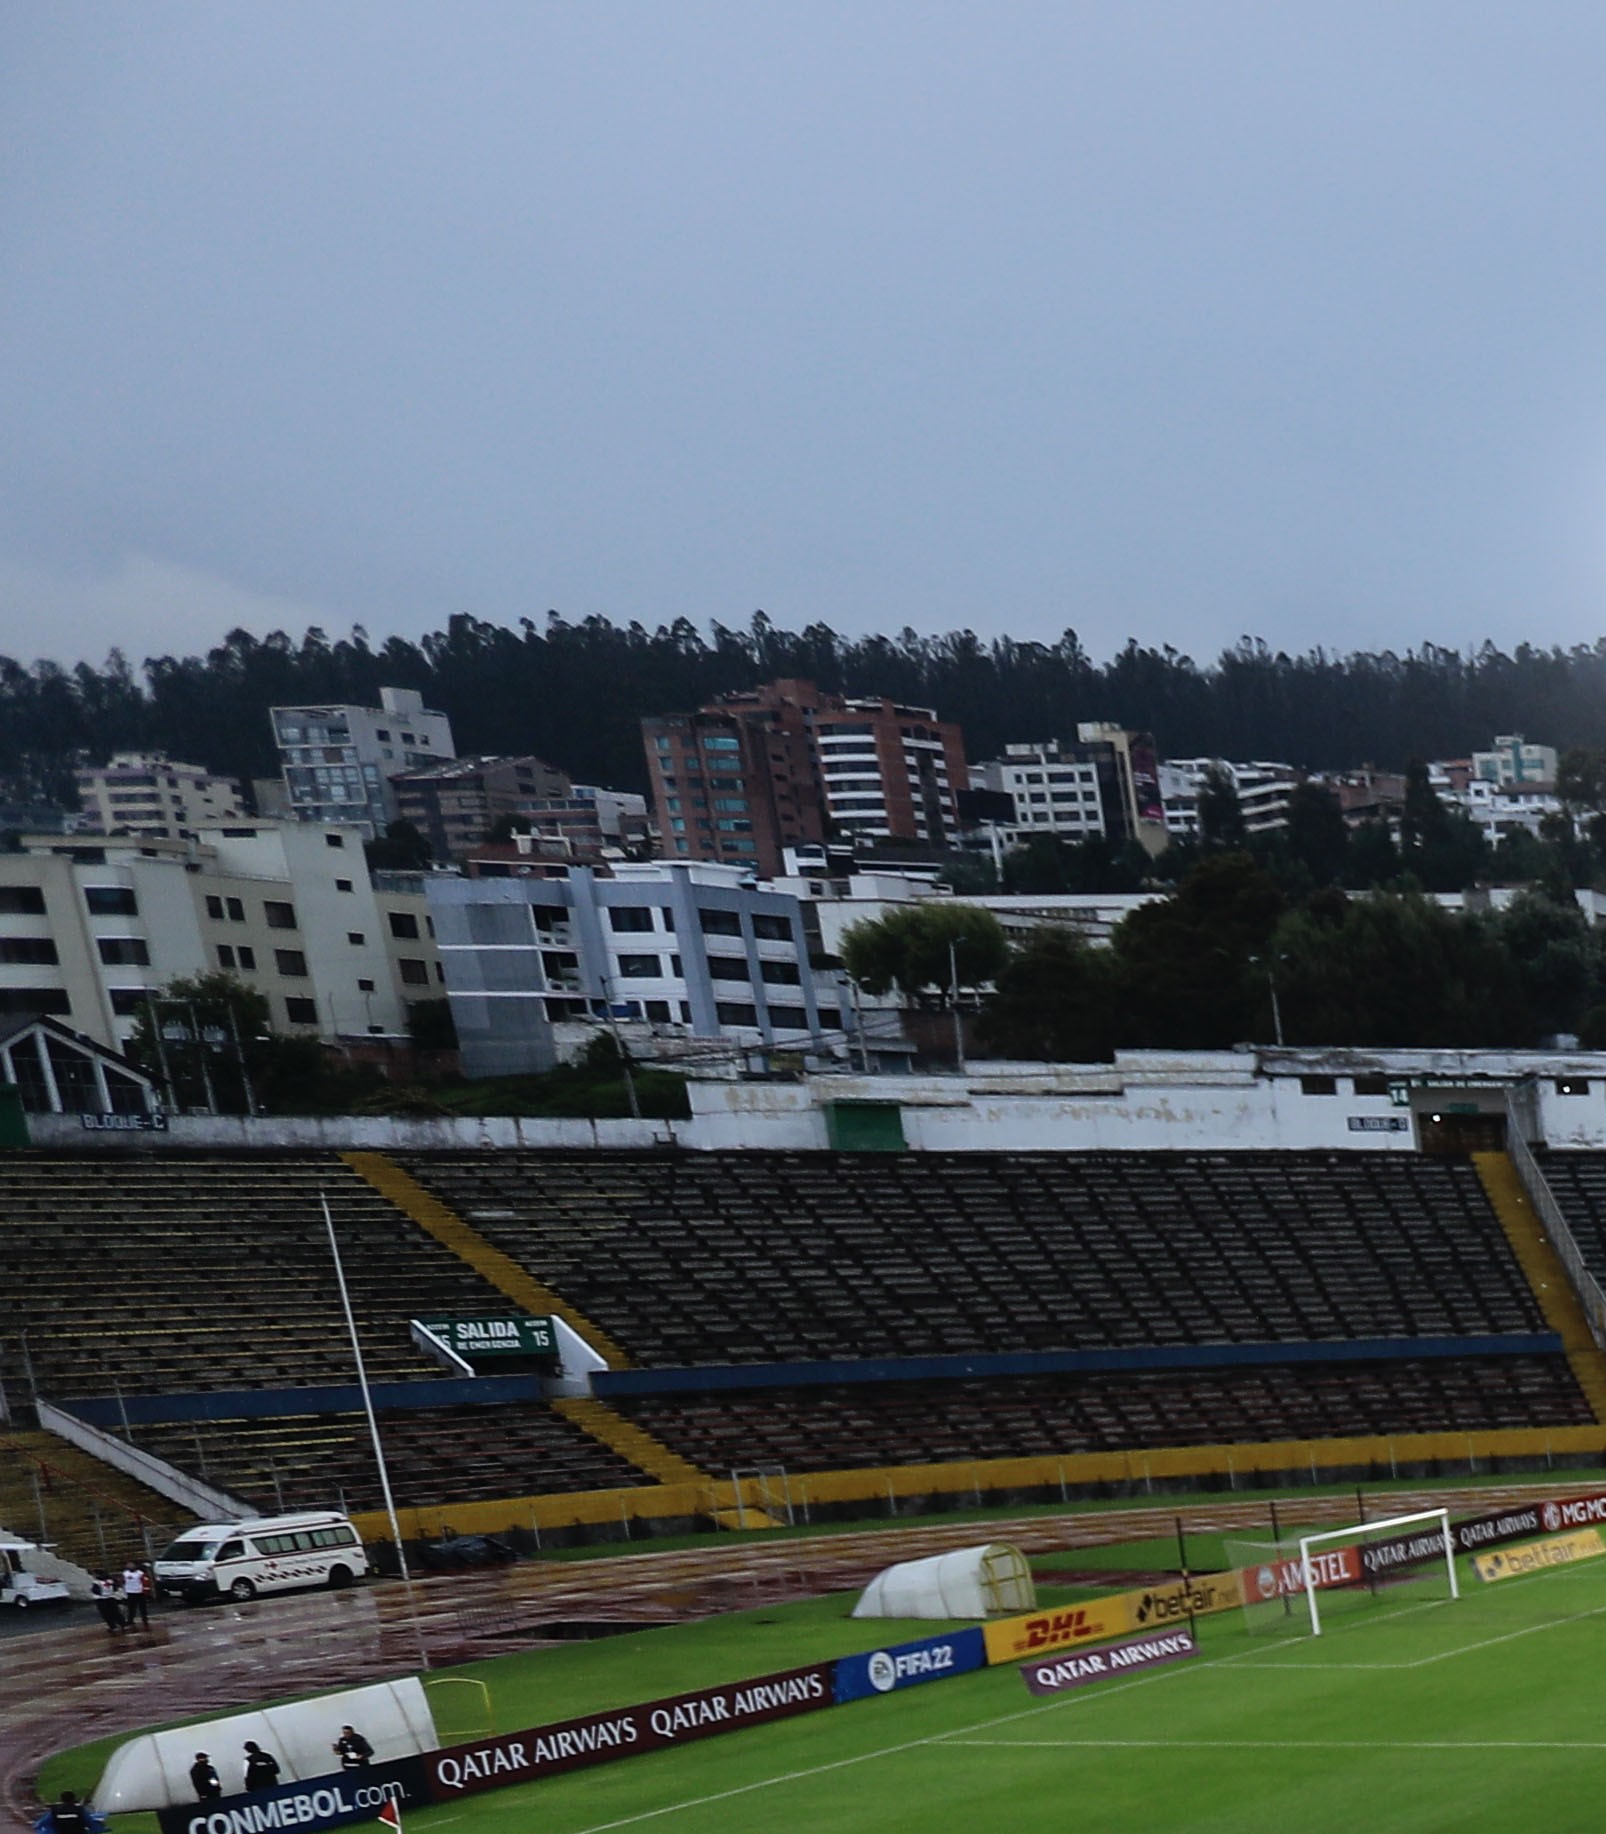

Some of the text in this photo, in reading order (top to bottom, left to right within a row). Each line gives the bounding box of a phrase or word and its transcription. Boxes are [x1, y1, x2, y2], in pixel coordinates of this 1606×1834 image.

[455, 1320, 520, 1339] SALIDA
[531, 1330, 550, 1347] 15
[1460, 1509, 1538, 1548] QATAR AIRWAYS
[1561, 1498, 1591, 1525] MG
[1363, 1541, 1407, 1572] QATAR
[1026, 1609, 1094, 1648] DHL
[1036, 1633, 1193, 1688] QATAR AIRWAYS
[650, 1672, 824, 1739] QATAR AIRWAYS
[436, 1715, 638, 1789] QATAR AIRWAYS
